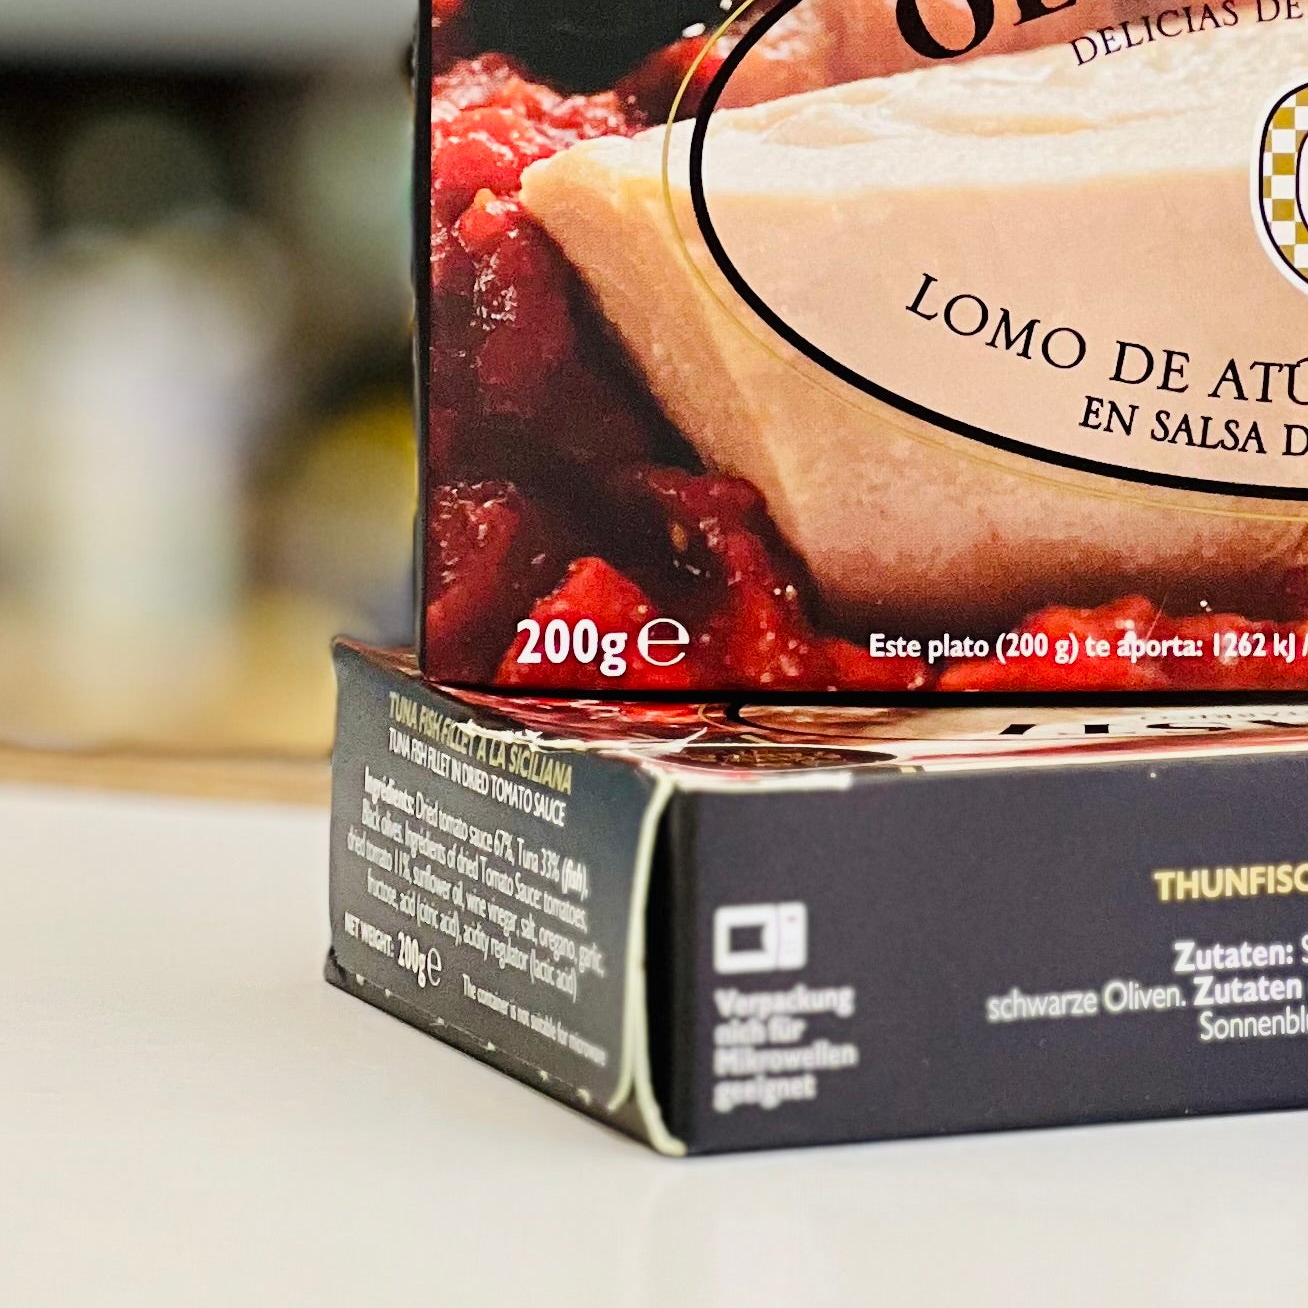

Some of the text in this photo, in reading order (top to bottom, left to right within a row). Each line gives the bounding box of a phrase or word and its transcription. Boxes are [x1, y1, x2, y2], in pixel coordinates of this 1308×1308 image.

[906, 272, 1087, 369] LOMO
[1109, 339, 1190, 394] DE
[1078, 394, 1140, 435] EN
[1150, 408, 1267, 455] SALSA
[516, 618, 628, 678] 200g
[869, 633, 921, 658] Este
[927, 632, 989, 664] plato
[996, 632, 1048, 664] (200
[1054, 632, 1077, 665] g)
[1085, 634, 1110, 658] te
[1116, 632, 1203, 664] aporta:
[1212, 632, 1267, 658] 1262
[1273, 632, 1296, 663] kJ
[389, 691, 418, 730] TUNA
[418, 704, 444, 742] FISH
[476, 735, 487, 762] A
[489, 738, 506, 770] LA
[508, 743, 572, 796] SICILIANA
[389, 726, 411, 761] TUNA
[410, 738, 428, 768] FISH
[427, 746, 451, 778] FILLET
[462, 762, 489, 796] DRIED
[490, 775, 532, 813] TOMATO
[533, 792, 567, 827] SAUCE
[415, 791, 439, 827] Dried
[439, 810, 468, 842] tomato
[469, 825, 493, 853] sauce
[517, 837, 538, 874] Tuna
[540, 848, 560, 883] 33%
[447, 843, 457, 869] of
[480, 855, 514, 897] Tomato
[1174, 941, 1294, 973] Zutaten:
[712, 983, 856, 1022] Verpackung
[985, 987, 1098, 1022] schwarze
[1103, 979, 1187, 1013] Oliven.
[1193, 975, 1302, 1006] Zutaten
